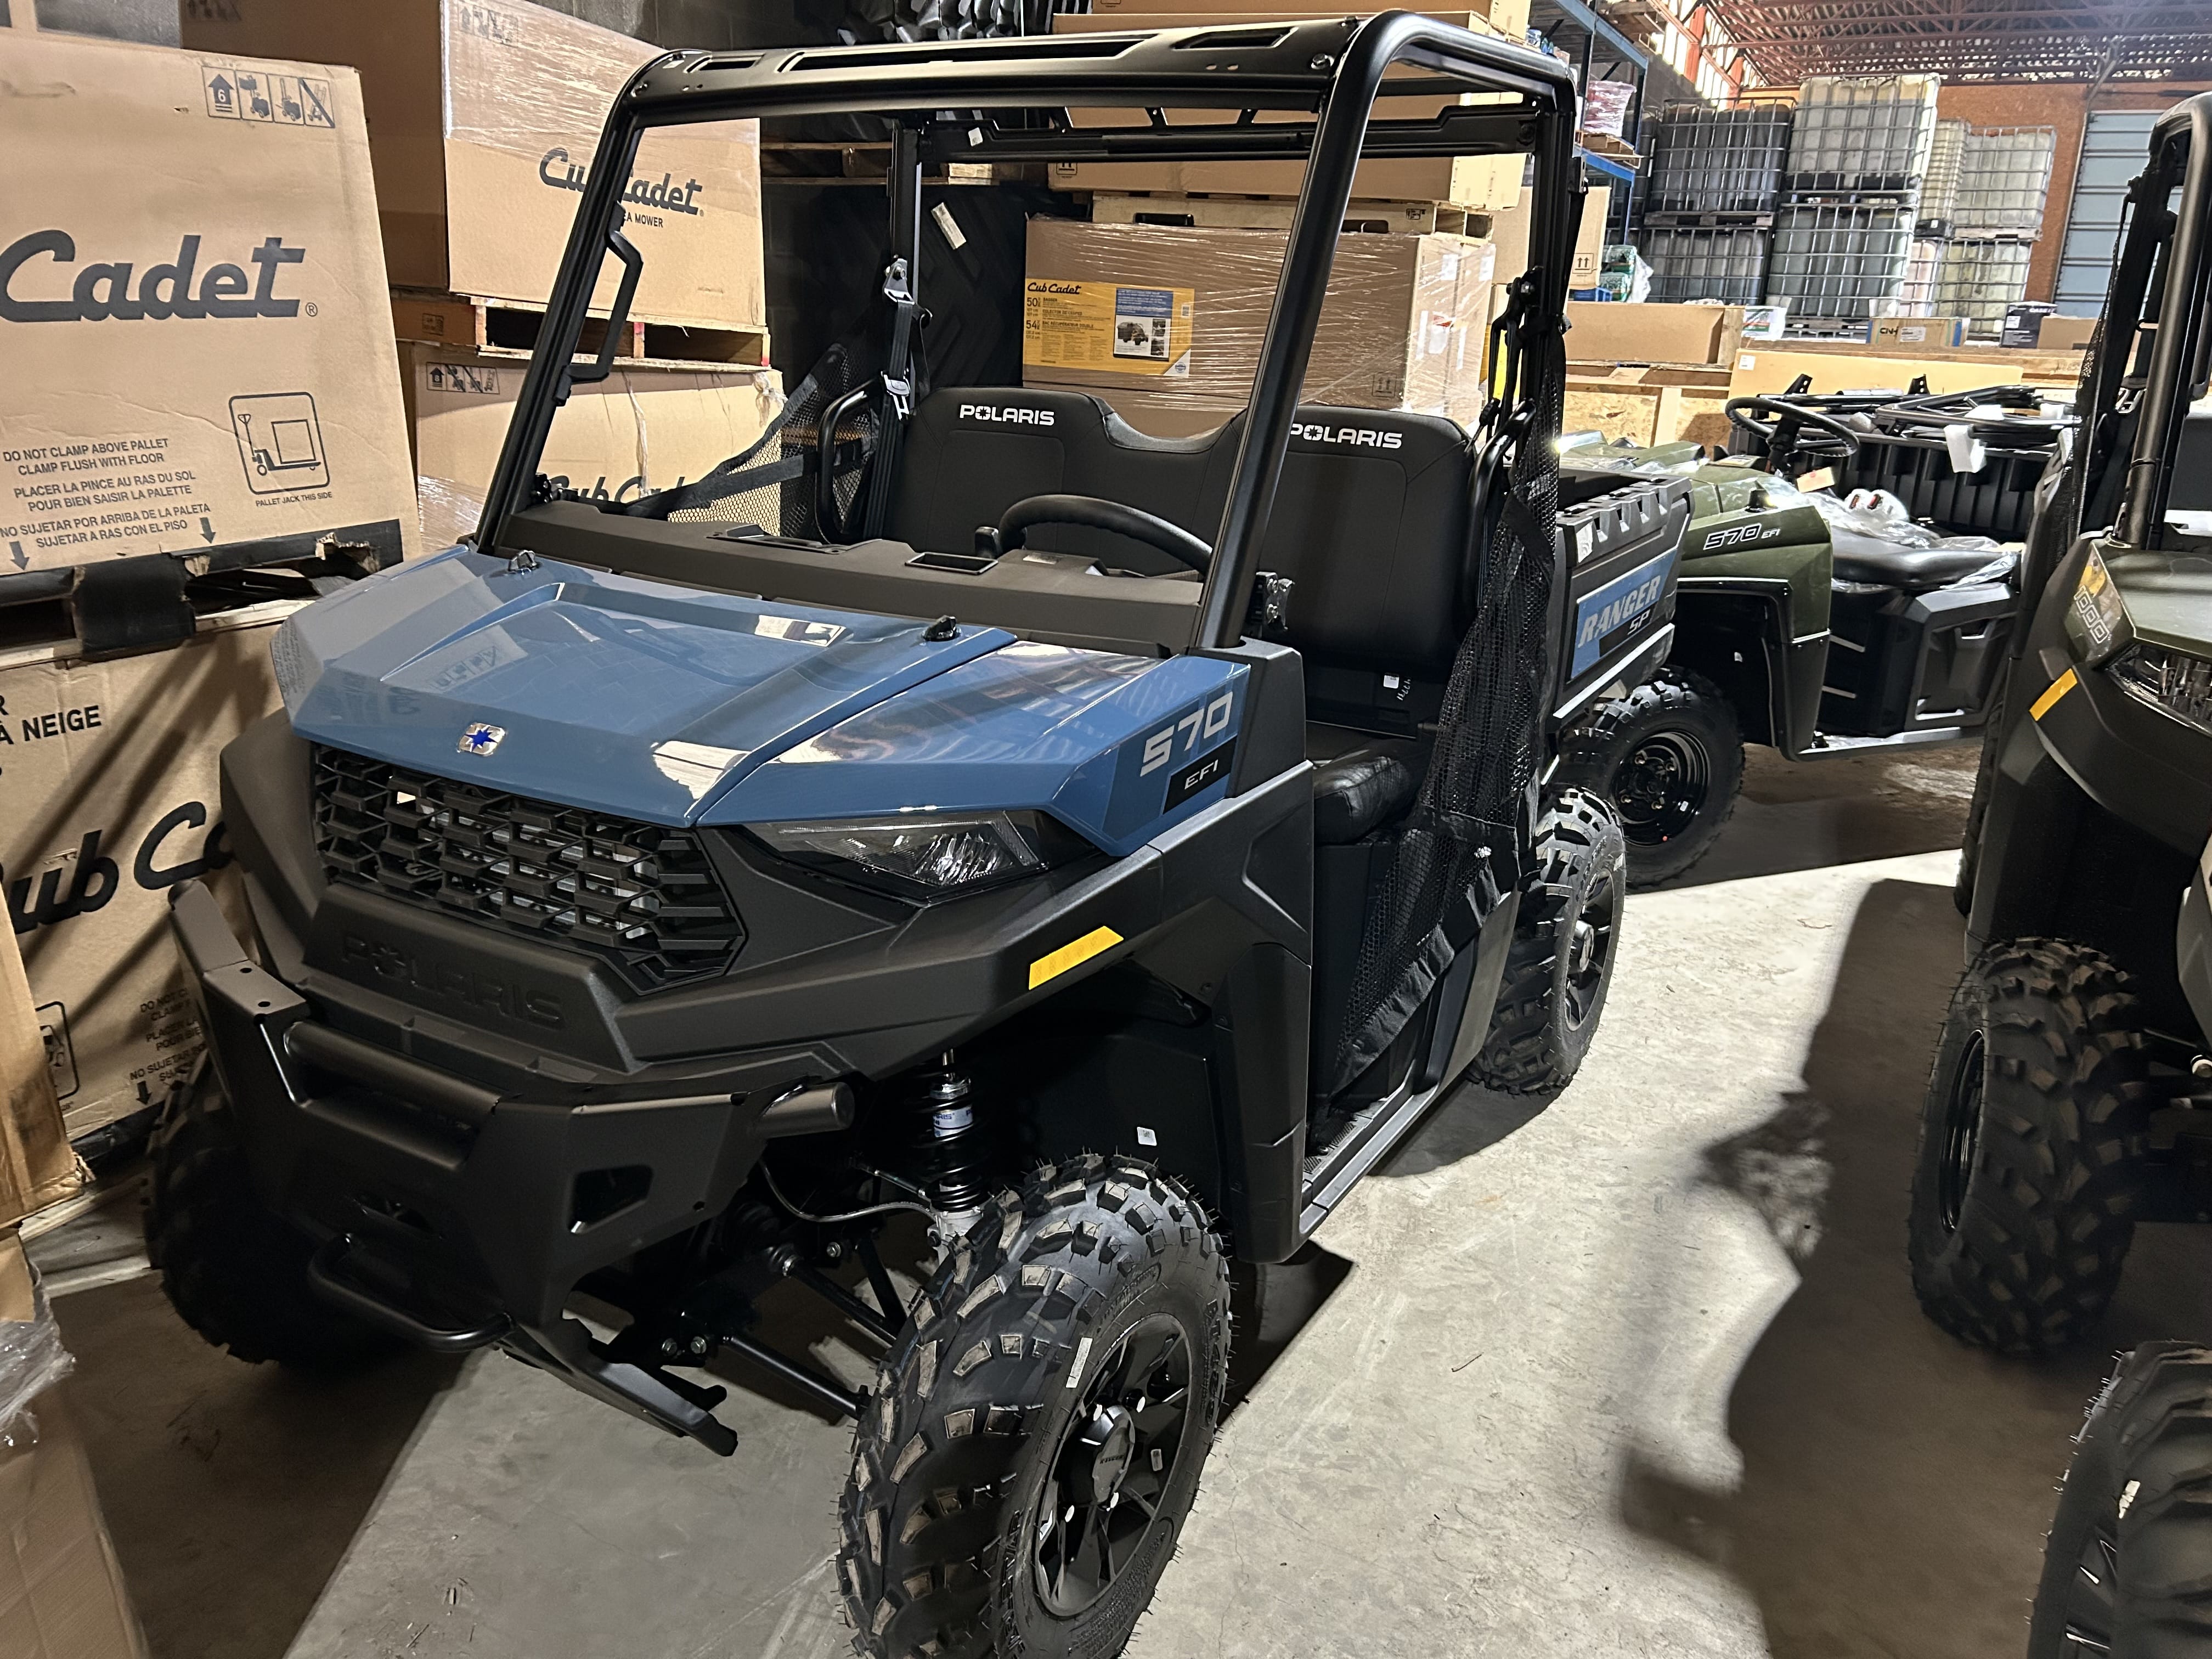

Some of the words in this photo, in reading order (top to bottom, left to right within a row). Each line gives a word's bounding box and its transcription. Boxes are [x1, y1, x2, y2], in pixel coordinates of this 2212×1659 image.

[218, 89, 226, 103] 6
[539, 147, 587, 193] Cu
[635, 213, 664, 228] MOWER
[0, 230, 306, 323] Cadet
[1028, 282, 1047, 292] Cub
[1048, 284, 1082, 295] Cadet
[1026, 297, 1037, 307] 50
[1026, 320, 1037, 329] 54
[960, 404, 1054, 426] POLARIS
[3, 450, 21, 461] DO
[23, 448, 47, 460] NOT
[50, 445, 89, 458] CLAMP
[92, 441, 129, 454] ABOVE
[131, 438, 168, 450] PALLET
[1290, 423, 1403, 449] POLARIS
[18, 462, 58, 476] CLAMP
[60, 459, 97, 471] FLUSH
[99, 456, 127, 467] WITH
[128, 453, 165, 465] FLOOR
[14, 484, 61, 498] PLACER
[63, 482, 79, 493] LA
[80, 478, 115, 492] PINCE
[117, 477, 132, 487] AU
[134, 474, 156, 486] RAS
[157, 472, 173, 483] DU
[175, 470, 196, 481] SOL
[28, 499, 63, 512] POUR
[64, 495, 92, 507] BIEN
[93, 492, 129, 504] SAISIR
[131, 490, 146, 500] LA
[147, 485, 192, 498] PALETTE
[256, 498, 280, 507] PALLET
[282, 495, 301, 504] JACK
[301, 493, 317, 501] THIS
[318, 492, 332, 500] SIDE
[0, 527, 18, 538] NO
[20, 520, 72, 535] SUJETAR
[74, 517, 98, 528] POR
[100, 512, 141, 525] ARRIBA
[142, 510, 157, 520] DE
[158, 507, 173, 518] LA
[173, 503, 211, 516] PALETA
[36, 533, 88, 548] SUJETAR
[90, 531, 99, 541] A
[99, 528, 122, 540] RAS
[124, 524, 148, 537] CON
[149, 523, 163, 533] EL
[164, 520, 188, 531] PISO
[1703, 522, 1762, 551] 570
[1761, 528, 1781, 539] EFI
[1577, 575, 1661, 648] RANGER
[1627, 609, 1651, 636] SP
[22, 705, 102, 742] NEIGE
[1140, 691, 1234, 777] 570
[1184, 759, 1219, 790] EFI
[0, 830, 120, 934] ub
[130, 1068, 146, 1080] NO
